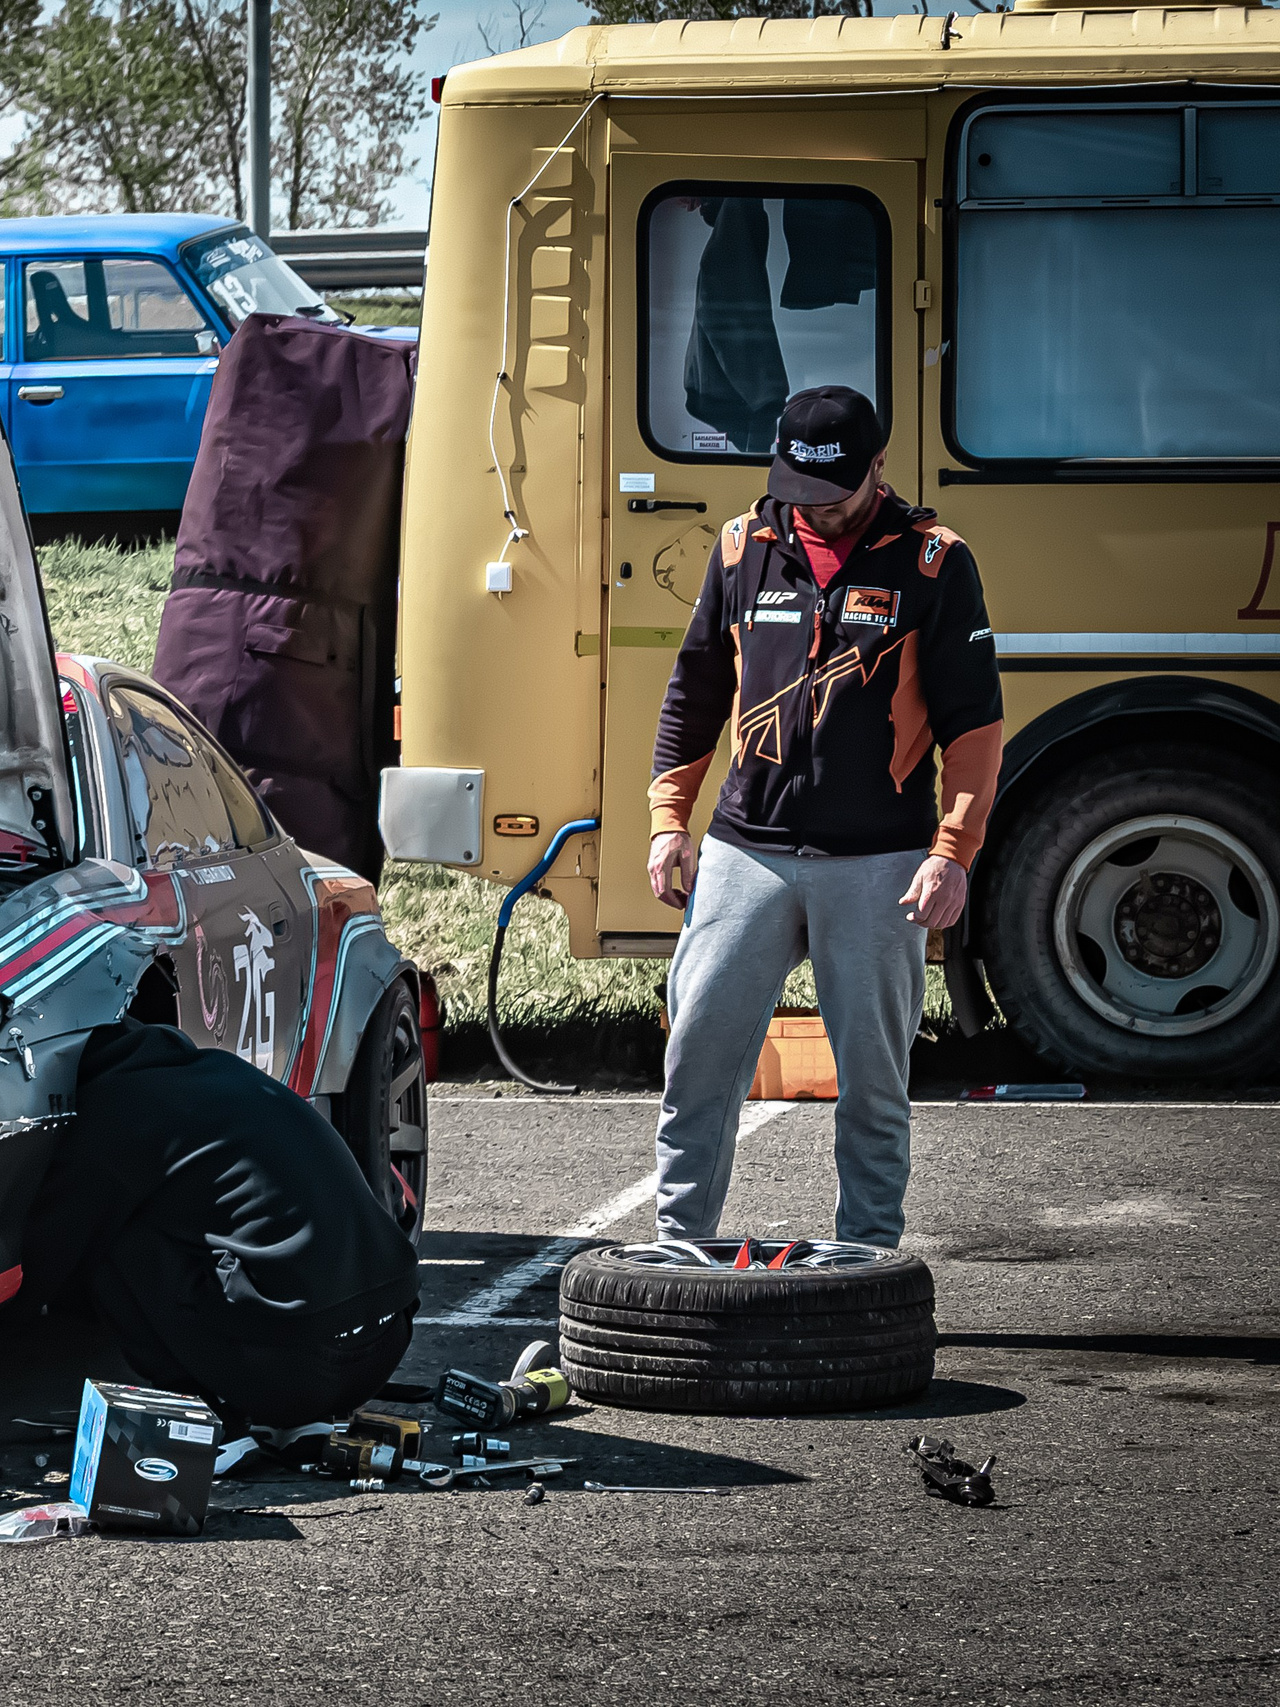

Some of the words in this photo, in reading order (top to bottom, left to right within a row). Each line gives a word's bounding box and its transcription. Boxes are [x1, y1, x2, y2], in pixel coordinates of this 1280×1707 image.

[213, 274, 258, 321] 13
[756, 590, 798, 605] WP
[844, 612, 872, 622] RACING
[446, 1376, 467, 1390] RYOBI
